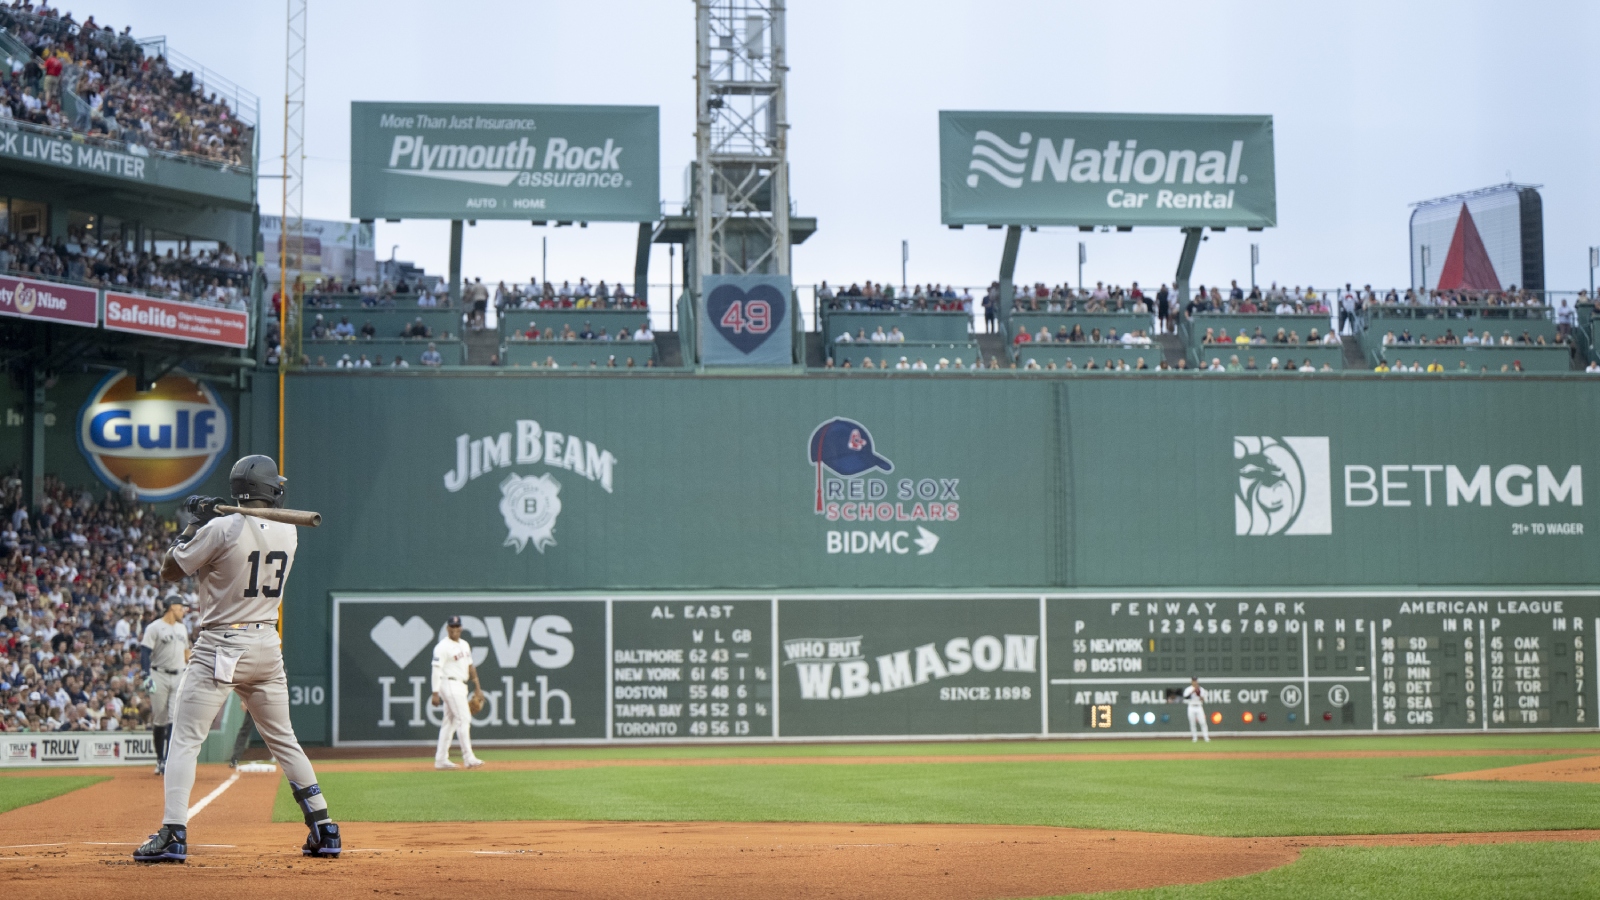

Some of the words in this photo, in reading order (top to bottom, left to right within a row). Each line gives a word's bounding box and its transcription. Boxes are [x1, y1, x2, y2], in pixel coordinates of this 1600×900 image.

[380, 113, 414, 129] More
[416, 114, 446, 129] Than
[448, 115, 474, 130] Just
[475, 116, 537, 131] Insurance.
[23, 135, 73, 165] LIVES
[77, 146, 145, 179] MATTER
[388, 135, 537, 172] Plymouth
[543, 138, 624, 170] Rock
[1030, 137, 1244, 185] National
[518, 171, 624, 188] assurance
[466, 198, 497, 209] AUTO
[513, 199, 546, 209] HOME
[1106, 189, 1148, 209] Car
[1156, 189, 1235, 209] Rental
[37, 291, 67, 311] Nine
[107, 301, 177, 329] Safelite
[720, 299, 771, 334] 49
[89, 409, 216, 449] Gulf
[443, 432, 512, 492] JIM
[515, 419, 614, 494] BEAM
[827, 479, 888, 500] RED
[898, 479, 960, 500] SOX
[1344, 464, 1583, 507] BETMGM
[826, 502, 960, 521] SCHOLARS
[1512, 523, 1529, 535] 21+
[1531, 523, 1545, 535] TO
[1546, 523, 1584, 535] WAGER
[826, 530, 909, 554] BIDMC
[243, 550, 288, 598] 13
[651, 605, 675, 618] AL
[684, 605, 734, 618] EAST
[1111, 602, 1217, 615] FENWAY
[1238, 602, 1305, 615] PARK
[1399, 601, 1488, 614] AMERICAN
[1497, 601, 1564, 613] LEAGUE
[1075, 620, 1085, 634] P
[1148, 619, 1154, 633] 1
[1161, 619, 1170, 633] 2
[1175, 619, 1185, 633] 3
[1193, 619, 1204, 633] 4
[1207, 619, 1217, 633] 5
[1221, 619, 1231, 633] 6
[1240, 619, 1249, 633] 7
[1254, 619, 1264, 633] 8
[1267, 619, 1278, 633] 9
[1285, 619, 1300, 633] 10
[1314, 619, 1325, 632] R
[1335, 619, 1345, 632] H
[1355, 619, 1364, 632] E
[1382, 618, 1392, 632] P
[1443, 619, 1457, 631] IN
[1463, 618, 1473, 631] R
[1491, 618, 1501, 631] P
[1553, 618, 1566, 631] IN
[1573, 617, 1584, 631] R
[438, 614, 574, 669] CVS
[692, 629, 704, 643] W
[715, 629, 725, 643] L
[732, 629, 752, 643] GB
[1409, 637, 1427, 650] SD
[1464, 637, 1473, 650] 6
[1490, 636, 1503, 650] 45
[1514, 637, 1540, 650] OAK
[1574, 636, 1583, 649] 6
[784, 641, 826, 659] WHO
[828, 640, 862, 658] BUT
[1336, 638, 1345, 651] 3
[614, 649, 684, 663] BALTIMORE
[689, 648, 708, 663] 62
[711, 648, 729, 663] 43
[1406, 651, 1431, 665] BAL
[1514, 651, 1540, 664] LAA
[1091, 658, 1142, 673] BOSTON
[1491, 666, 1504, 679] 22
[1515, 666, 1541, 679] TEX
[615, 667, 643, 681] NEW
[646, 667, 681, 681] YORK
[690, 666, 705, 681] 61
[711, 666, 729, 681] 45
[739, 666, 745, 681] 1
[1383, 667, 1394, 680] 17
[1407, 667, 1430, 680] MIN
[614, 685, 668, 699] BOSTON
[689, 684, 708, 699] 55
[711, 684, 729, 699] 48
[736, 684, 748, 699] 6
[940, 686, 991, 700] SINCE
[994, 686, 1031, 700] 1898
[1406, 681, 1432, 694] DET
[1492, 680, 1503, 693] 17
[1515, 680, 1541, 693] TOR
[1575, 679, 1584, 692] 7
[291, 685, 325, 705] 310
[378, 675, 576, 727] Health
[1075, 691, 1092, 704] AT
[1095, 691, 1118, 704] BAT
[1238, 689, 1269, 703] OUT
[1286, 690, 1296, 702] H
[1334, 689, 1343, 701] E
[1383, 696, 1396, 709] 50
[1407, 696, 1433, 709] SEA
[1466, 695, 1475, 709] 6
[1493, 695, 1503, 708] 21
[1518, 695, 1539, 708] CIN
[615, 703, 655, 717] TAMPA
[658, 703, 683, 717] BAY
[689, 702, 707, 717] 54
[711, 702, 729, 717] 52
[736, 702, 748, 717] 8
[1091, 705, 1112, 728] 13
[1407, 710, 1433, 724] CWS
[1520, 709, 1538, 723] TB
[1576, 709, 1585, 722] 2
[615, 721, 678, 736] TORONTO
[689, 720, 708, 735] 49
[711, 720, 729, 735] 56
[735, 720, 749, 735] 13
[42, 740, 79, 755] TRULY
[125, 739, 156, 754] TRUL
